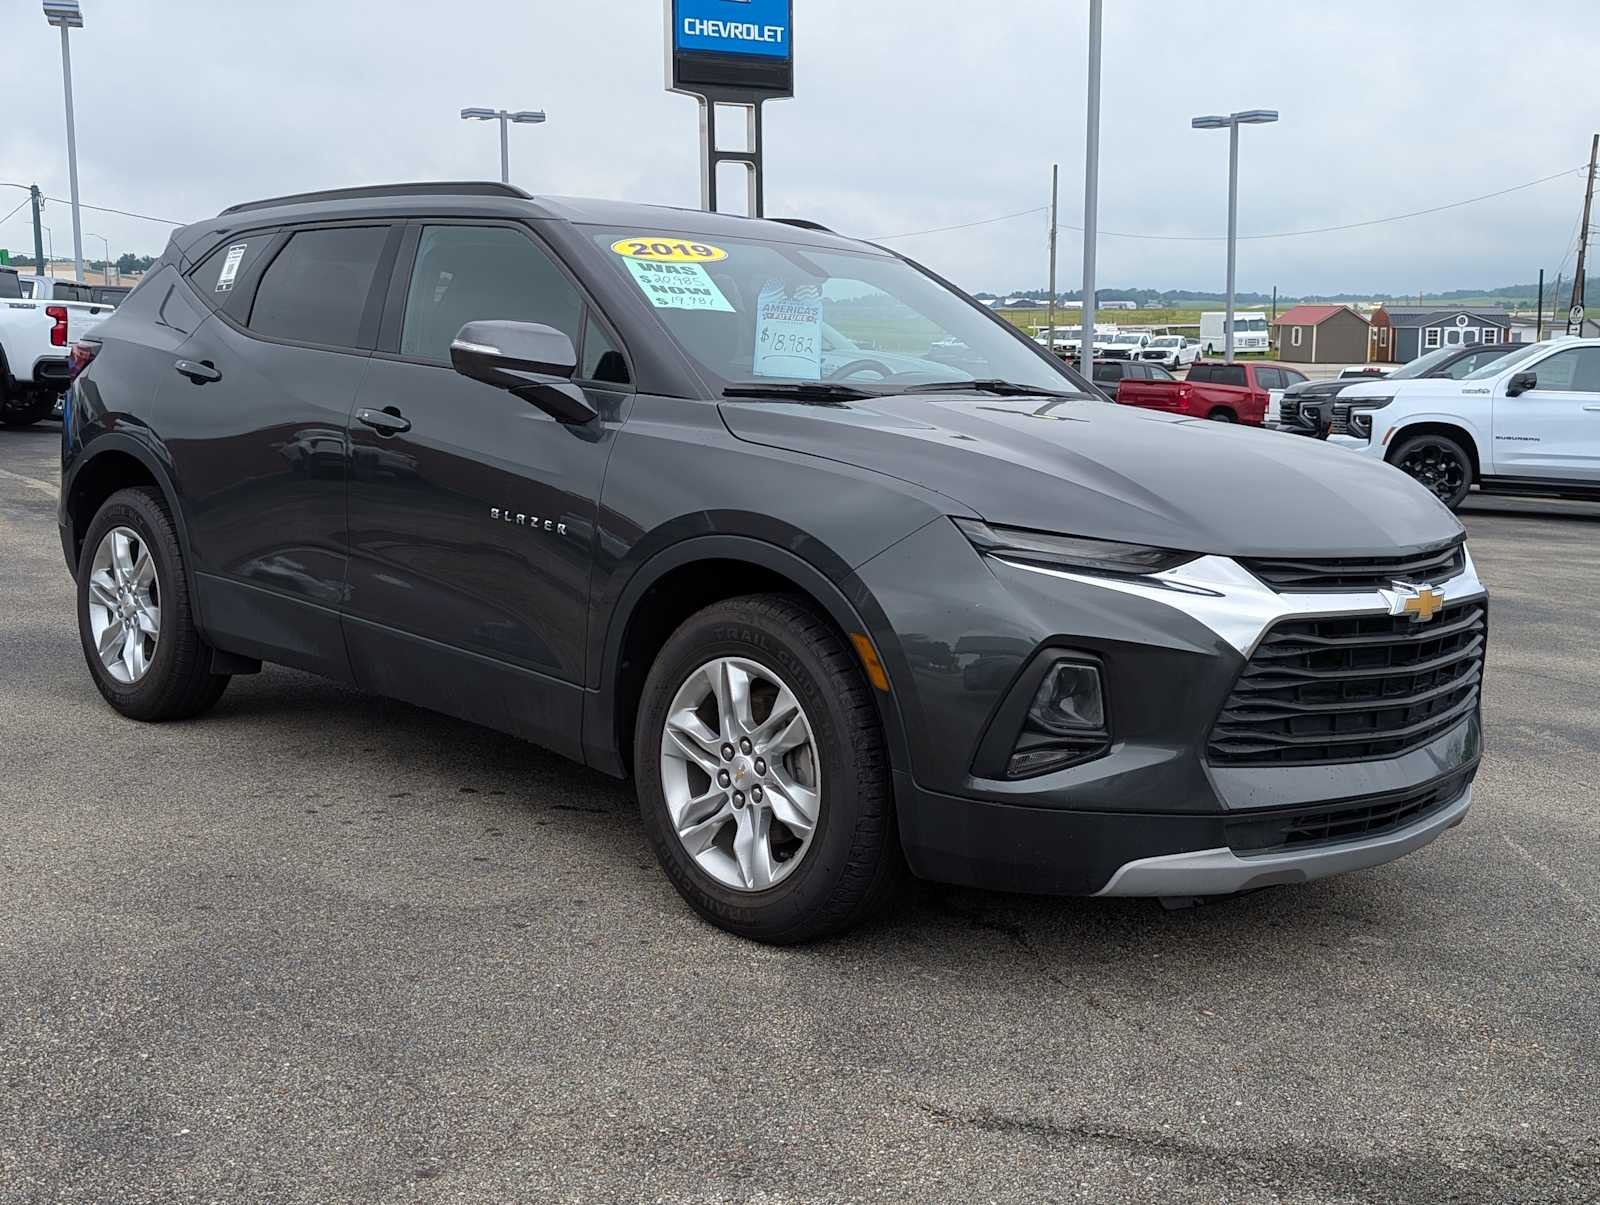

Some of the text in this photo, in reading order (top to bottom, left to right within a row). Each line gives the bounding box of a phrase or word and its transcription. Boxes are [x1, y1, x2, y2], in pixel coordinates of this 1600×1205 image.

[684, 17, 785, 43] CHEVROLET
[627, 242, 713, 257] 2019
[637, 263, 698, 275] WAS
[650, 285, 712, 295] NOW
[760, 326, 814, 354] $18,982
[490, 507, 567, 535] BLAZER
